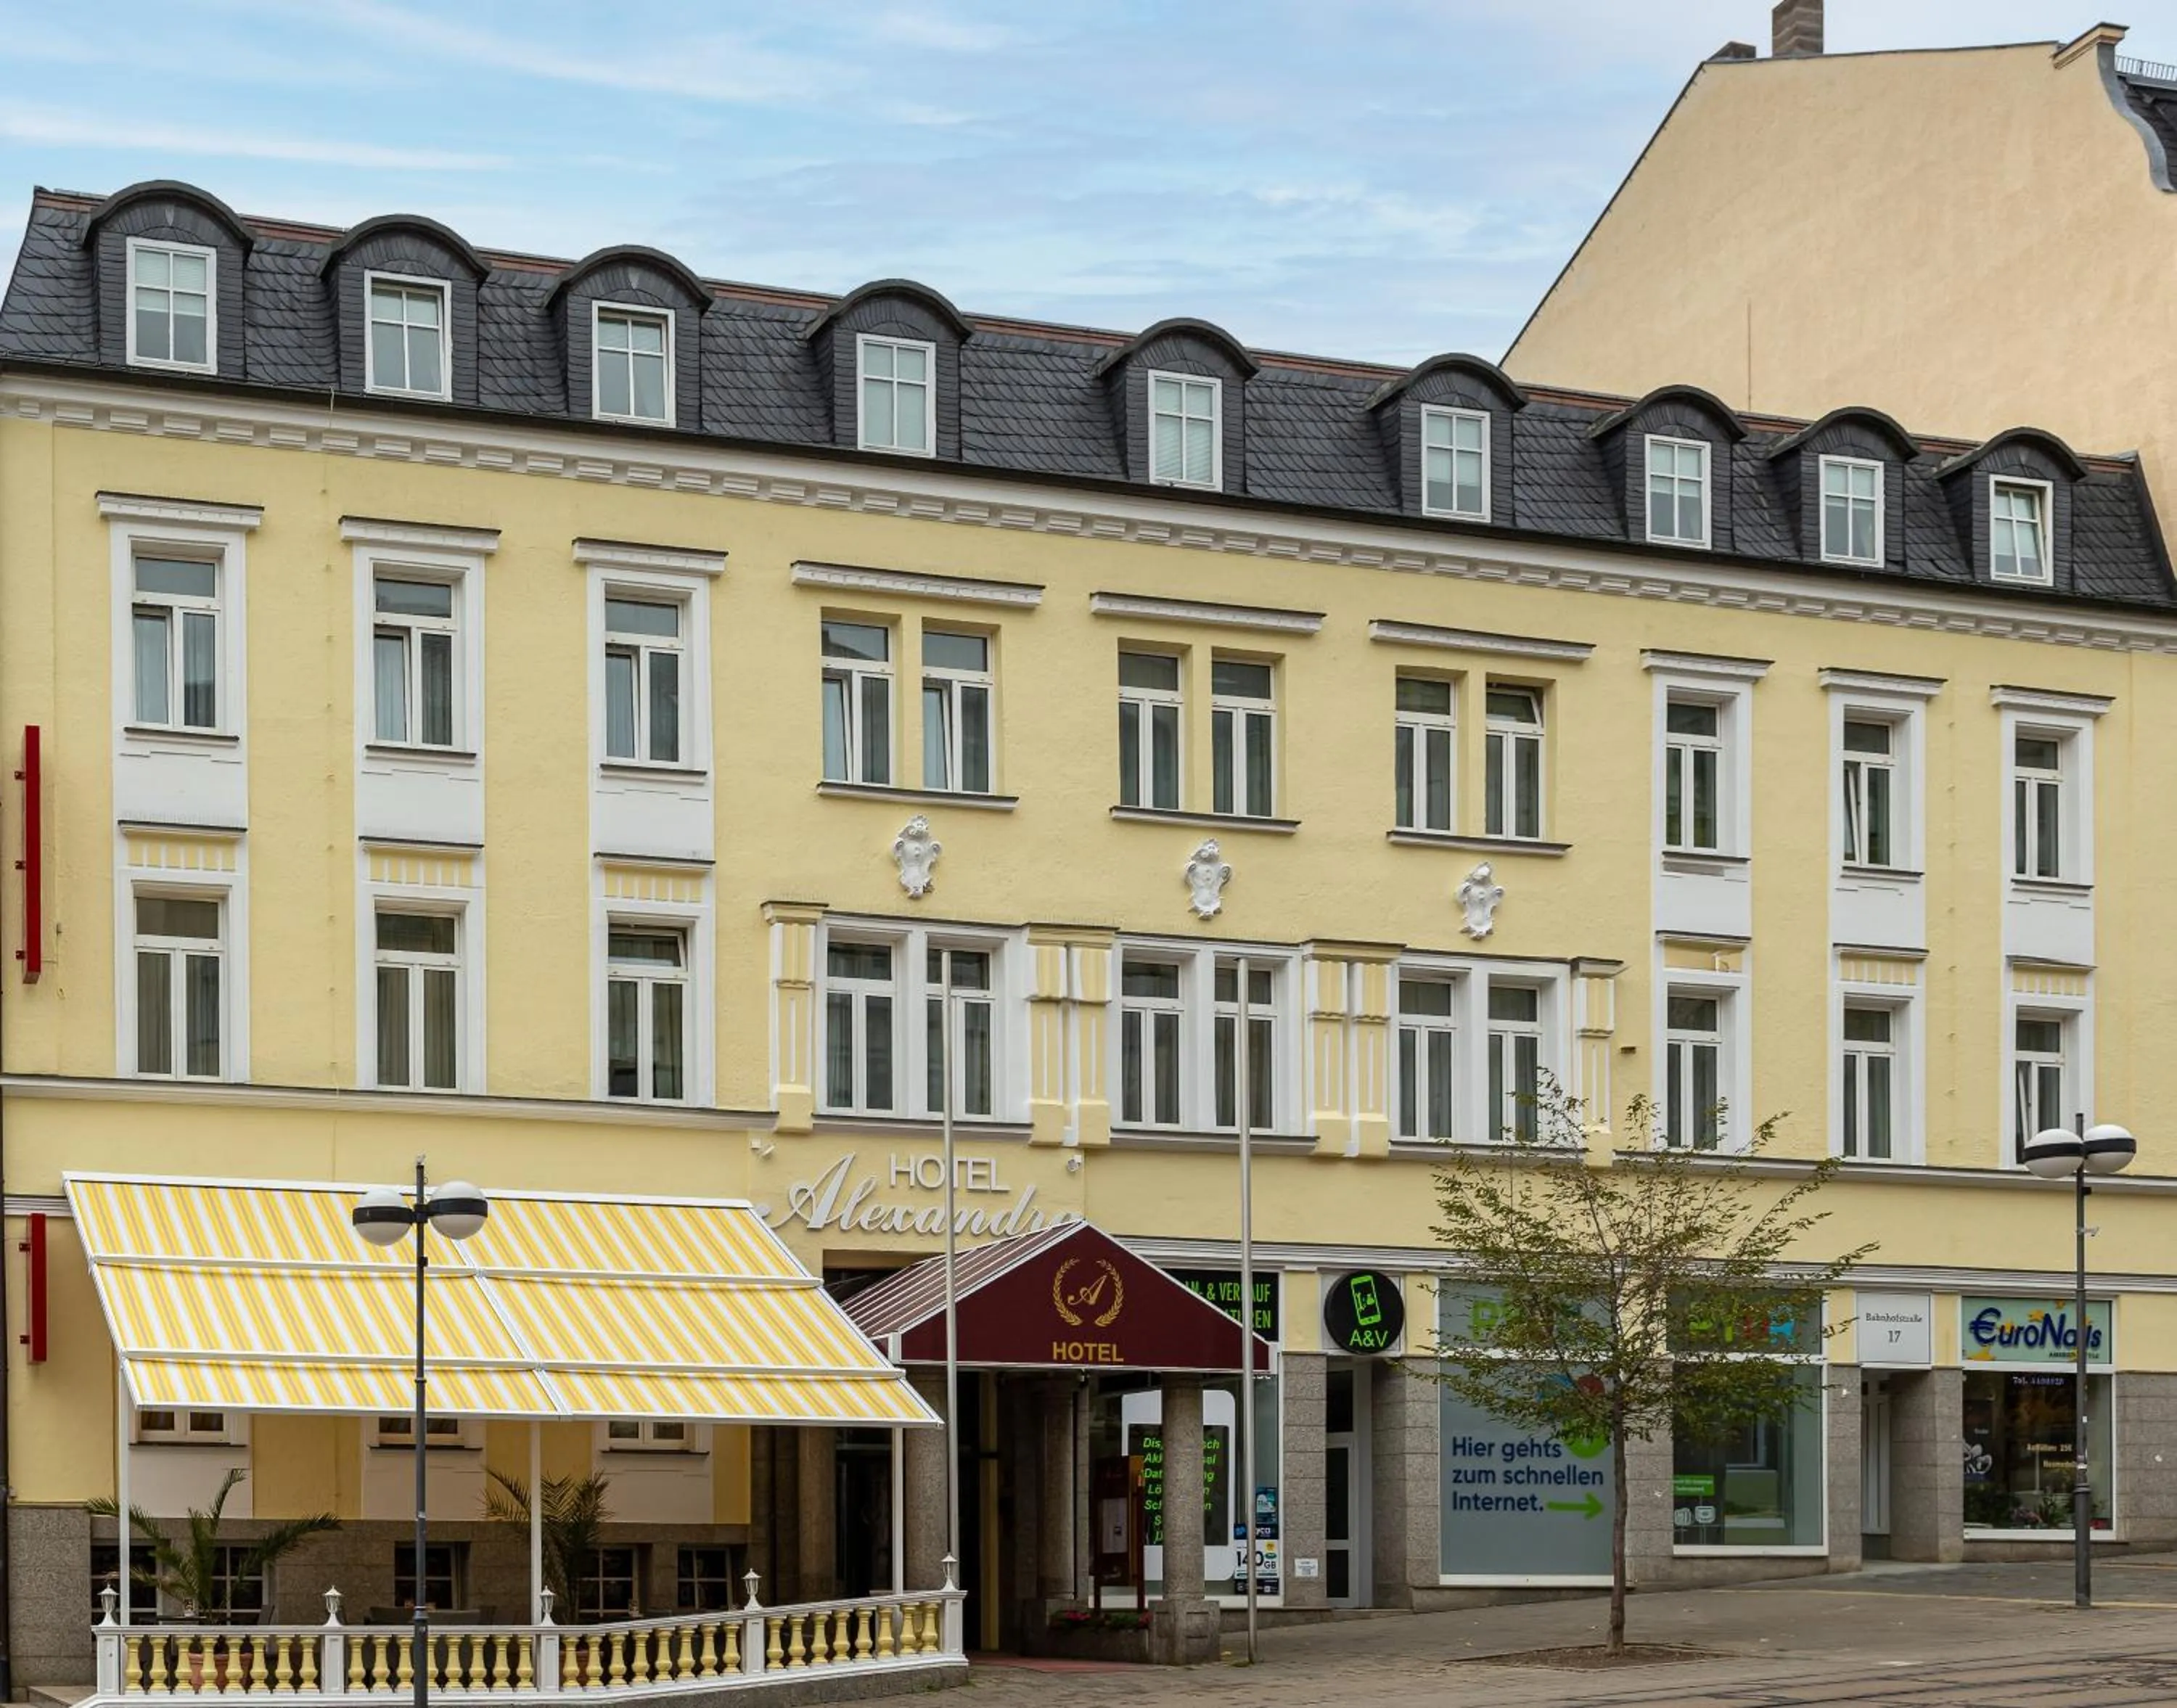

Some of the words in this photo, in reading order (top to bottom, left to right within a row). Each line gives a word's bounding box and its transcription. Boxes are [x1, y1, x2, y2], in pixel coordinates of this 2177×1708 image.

[890, 1154, 1012, 1192] HOTEL
[1207, 1282, 1216, 1301] &
[1219, 1282, 1271, 1303] VERUF
[1349, 1329, 1389, 1347] A&V
[1888, 1330, 1901, 1343] 17
[1053, 1342, 1124, 1363] HOTEL
[1452, 1436, 1496, 1457] Hier
[1501, 1437, 1562, 1463] gehts
[1452, 1469, 1496, 1485] zum
[1504, 1464, 1604, 1486] schnellen
[1452, 1491, 1544, 1512] Internet.
[1263, 1561, 1277, 1569] GB
